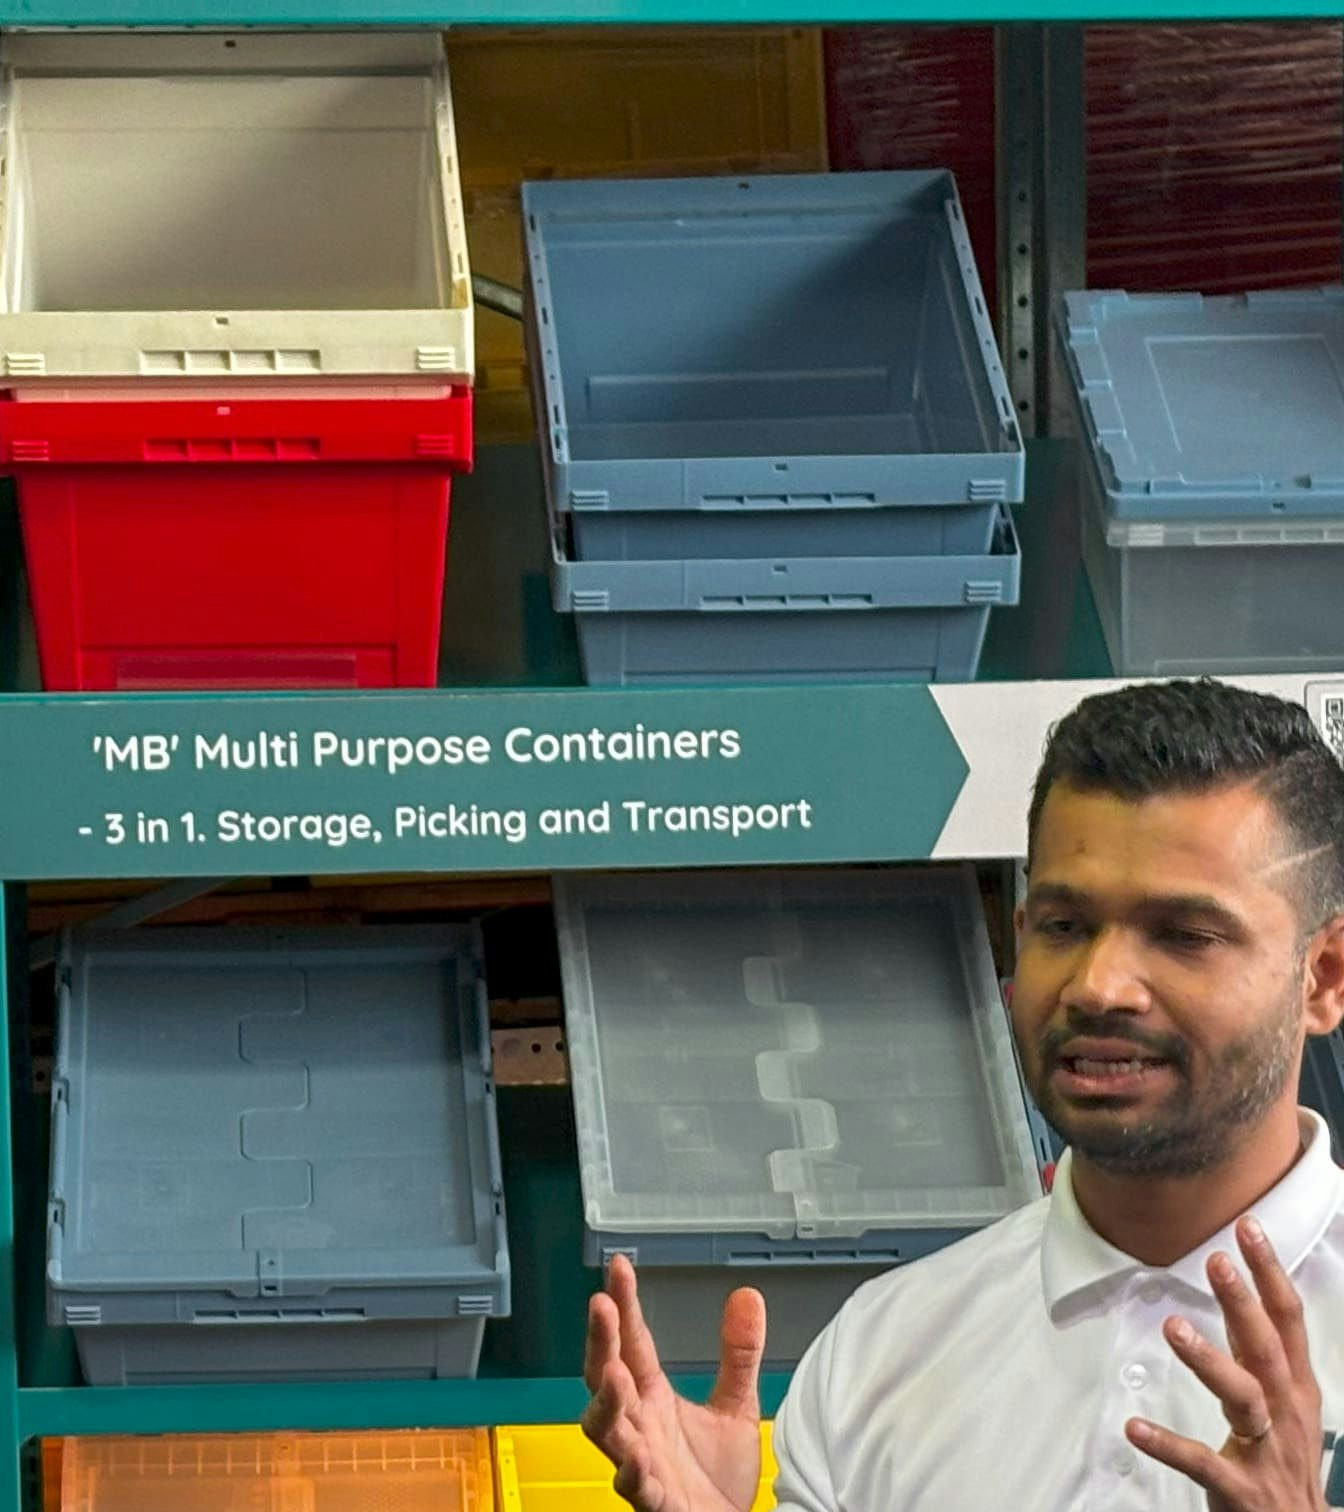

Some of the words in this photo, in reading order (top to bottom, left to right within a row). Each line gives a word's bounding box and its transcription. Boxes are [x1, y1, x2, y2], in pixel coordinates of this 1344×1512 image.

[93, 735, 179, 771] 'MB'
[194, 731, 299, 768] Multi
[313, 731, 492, 775] Purpose
[505, 723, 741, 763] Containers
[104, 813, 126, 844] 3
[137, 812, 169, 843] in
[180, 812, 206, 843] 1.
[217, 810, 383, 847] Storage,
[395, 804, 527, 843] Picking
[539, 800, 610, 835] and
[622, 799, 811, 838] Transport
